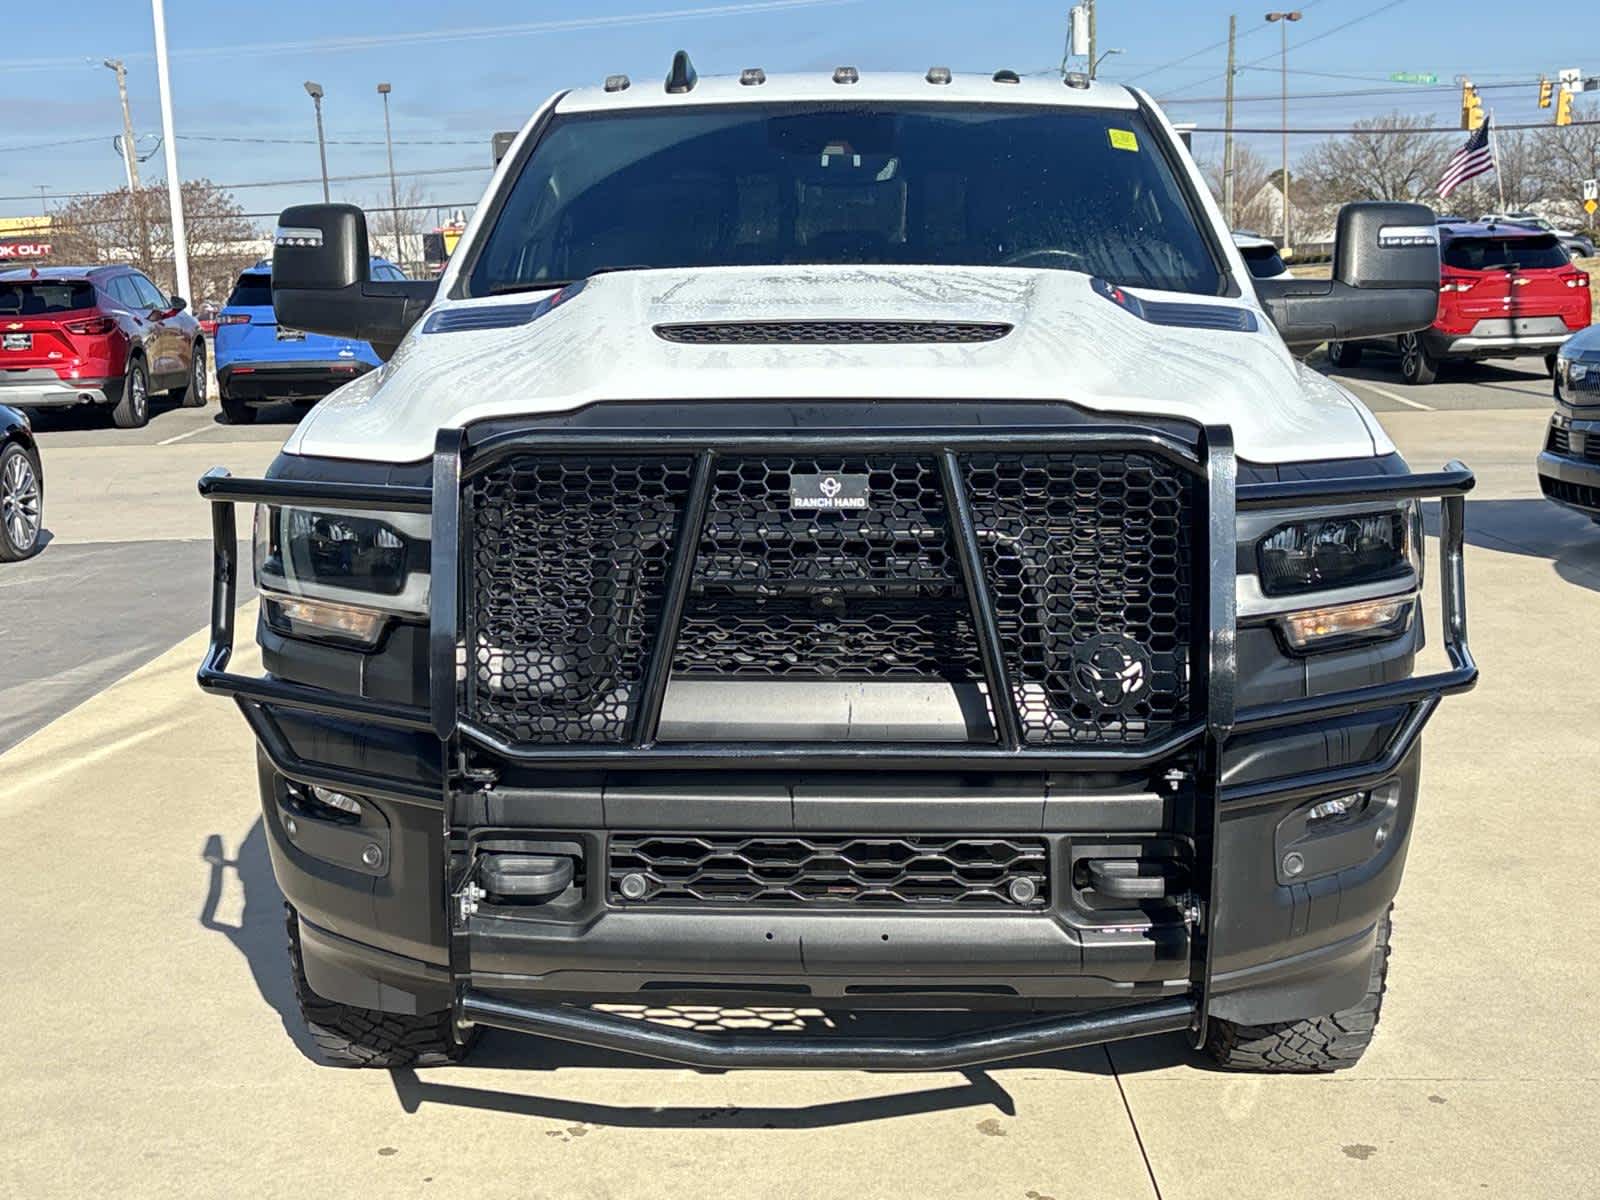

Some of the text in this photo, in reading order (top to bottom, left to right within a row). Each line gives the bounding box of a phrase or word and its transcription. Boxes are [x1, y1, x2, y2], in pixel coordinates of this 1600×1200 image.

[18, 244, 51, 256] OUT
[794, 497, 865, 507] RANCH HAND
